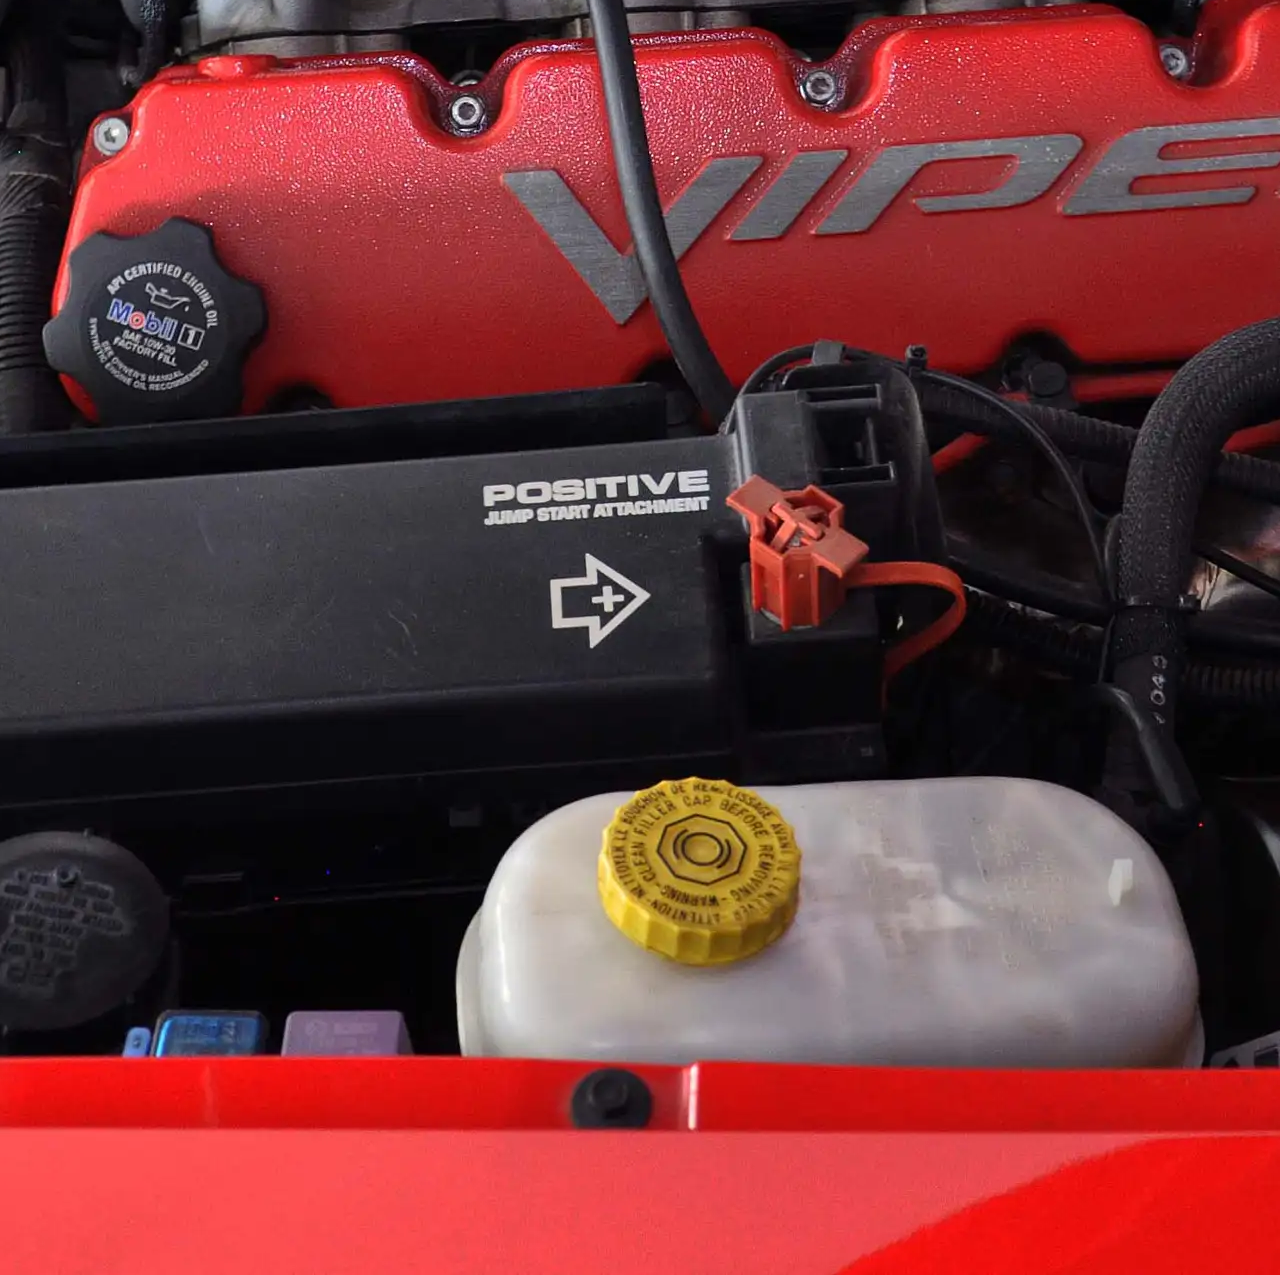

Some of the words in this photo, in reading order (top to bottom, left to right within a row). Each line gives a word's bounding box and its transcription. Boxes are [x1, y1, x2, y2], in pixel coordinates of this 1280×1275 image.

[107, 276, 126, 295] API
[124, 262, 182, 281] CERTIFIED
[181, 272, 215, 309] ENGINE
[206, 310, 218, 329] OIL
[106, 298, 178, 341] Mobil
[113, 336, 158, 359] FACTORY
[158, 352, 177, 367] FILL
[122, 330, 142, 343] SAE
[104, 362, 133, 386] ENGINE
[133, 380, 147, 391] OIL
[111, 357, 146, 381] OWNER'S
[148, 370, 184, 382] MANUAL
[483, 470, 709, 507] POSITIVE
[484, 508, 532, 527] JUMP
[537, 504, 589, 522] START
[593, 496, 709, 519] ATTACHMENT
[670, 784, 685, 794] DE
[682, 796, 712, 808] CAP
[622, 790, 667, 823] BOUCHON
[633, 800, 678, 836] FILLER
[720, 800, 768, 839] BEFORE
[617, 829, 627, 841] LE
[631, 840, 656, 883] CLEAN
[731, 844, 774, 902] REMOVING
[661, 886, 720, 907] WARNING
[651, 900, 721, 925] ATTENTION
